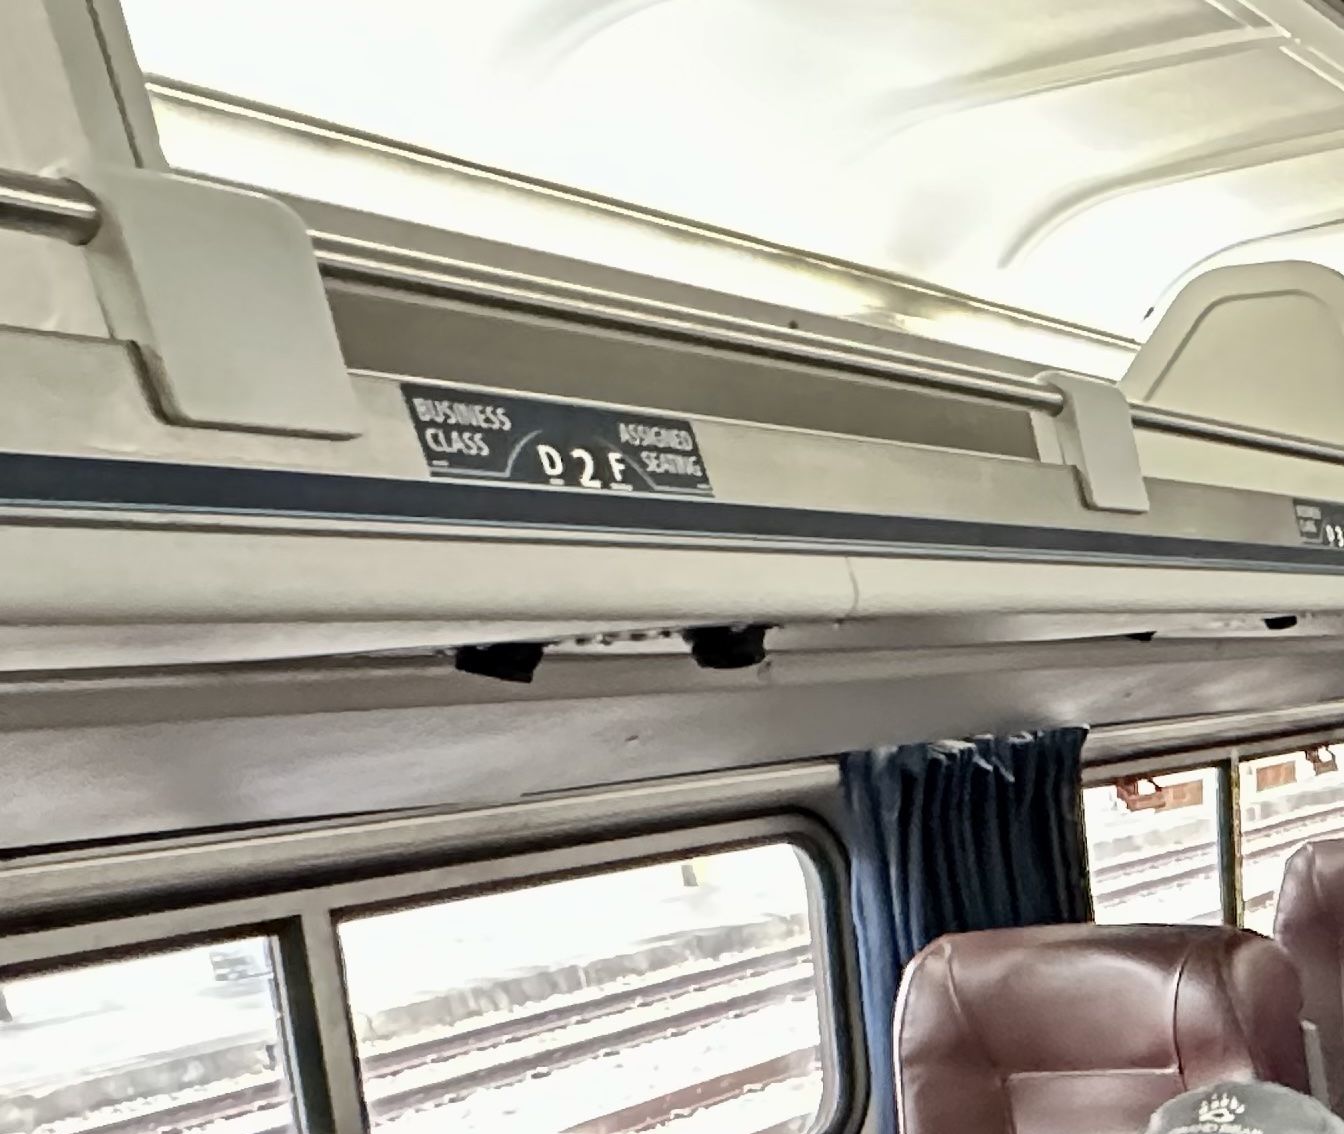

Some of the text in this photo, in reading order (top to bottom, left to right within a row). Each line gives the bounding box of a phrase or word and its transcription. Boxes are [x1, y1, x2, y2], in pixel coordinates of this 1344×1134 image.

[412, 398, 512, 431] BUSINESS
[425, 427, 490, 456] CLASS
[536, 443, 628, 489] D 2 F
